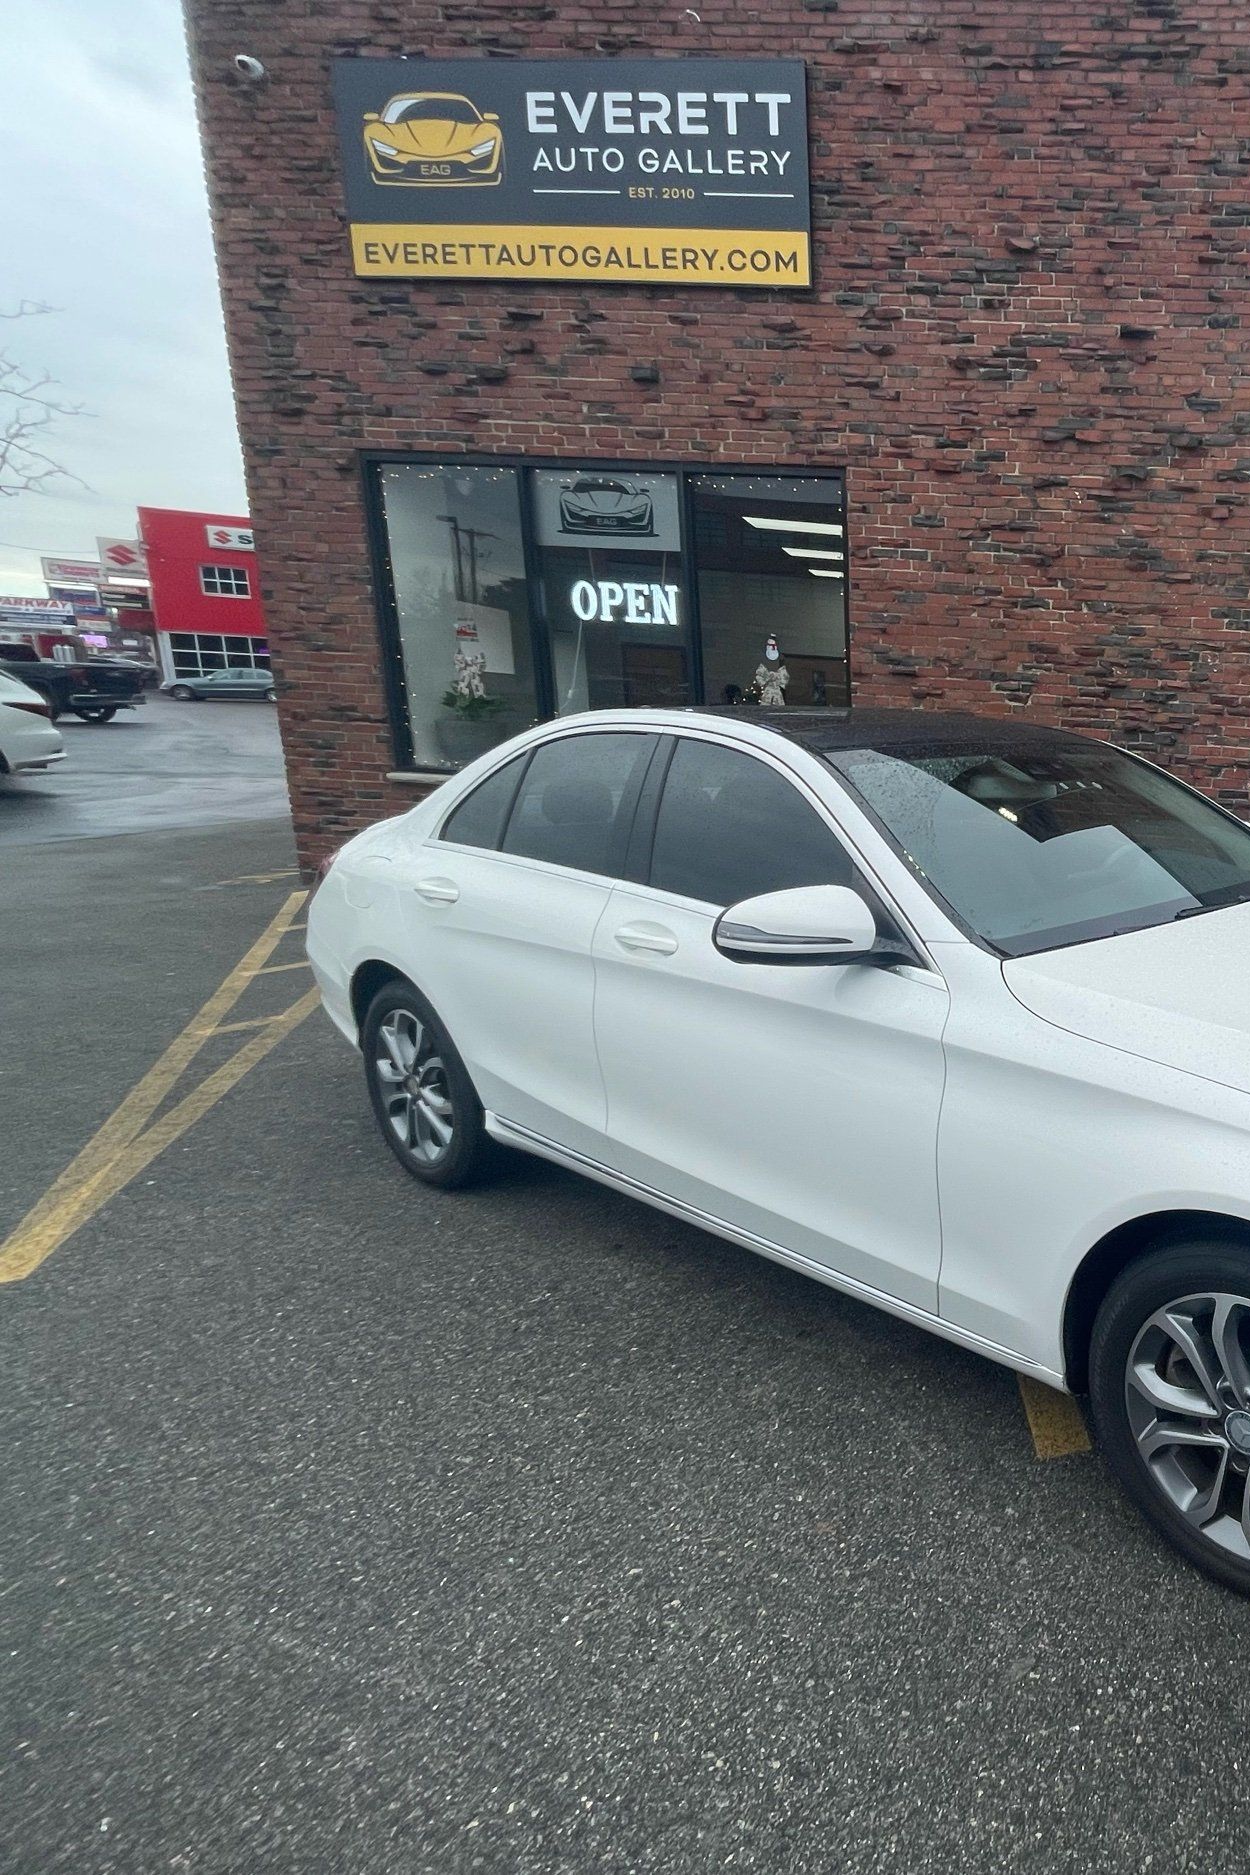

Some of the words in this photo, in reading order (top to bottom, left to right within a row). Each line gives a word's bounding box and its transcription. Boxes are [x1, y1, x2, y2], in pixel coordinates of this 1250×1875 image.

[525, 91, 792, 137] EVERETT
[420, 164, 452, 176] EAG
[532, 147, 625, 174] AUTO
[638, 147, 792, 176] GALLERY
[628, 186, 659, 199] EST.
[662, 187, 696, 200] 2010
[364, 242, 799, 273] EVERETTAUTOGALLERY.COM
[570, 579, 680, 626] OPEN
